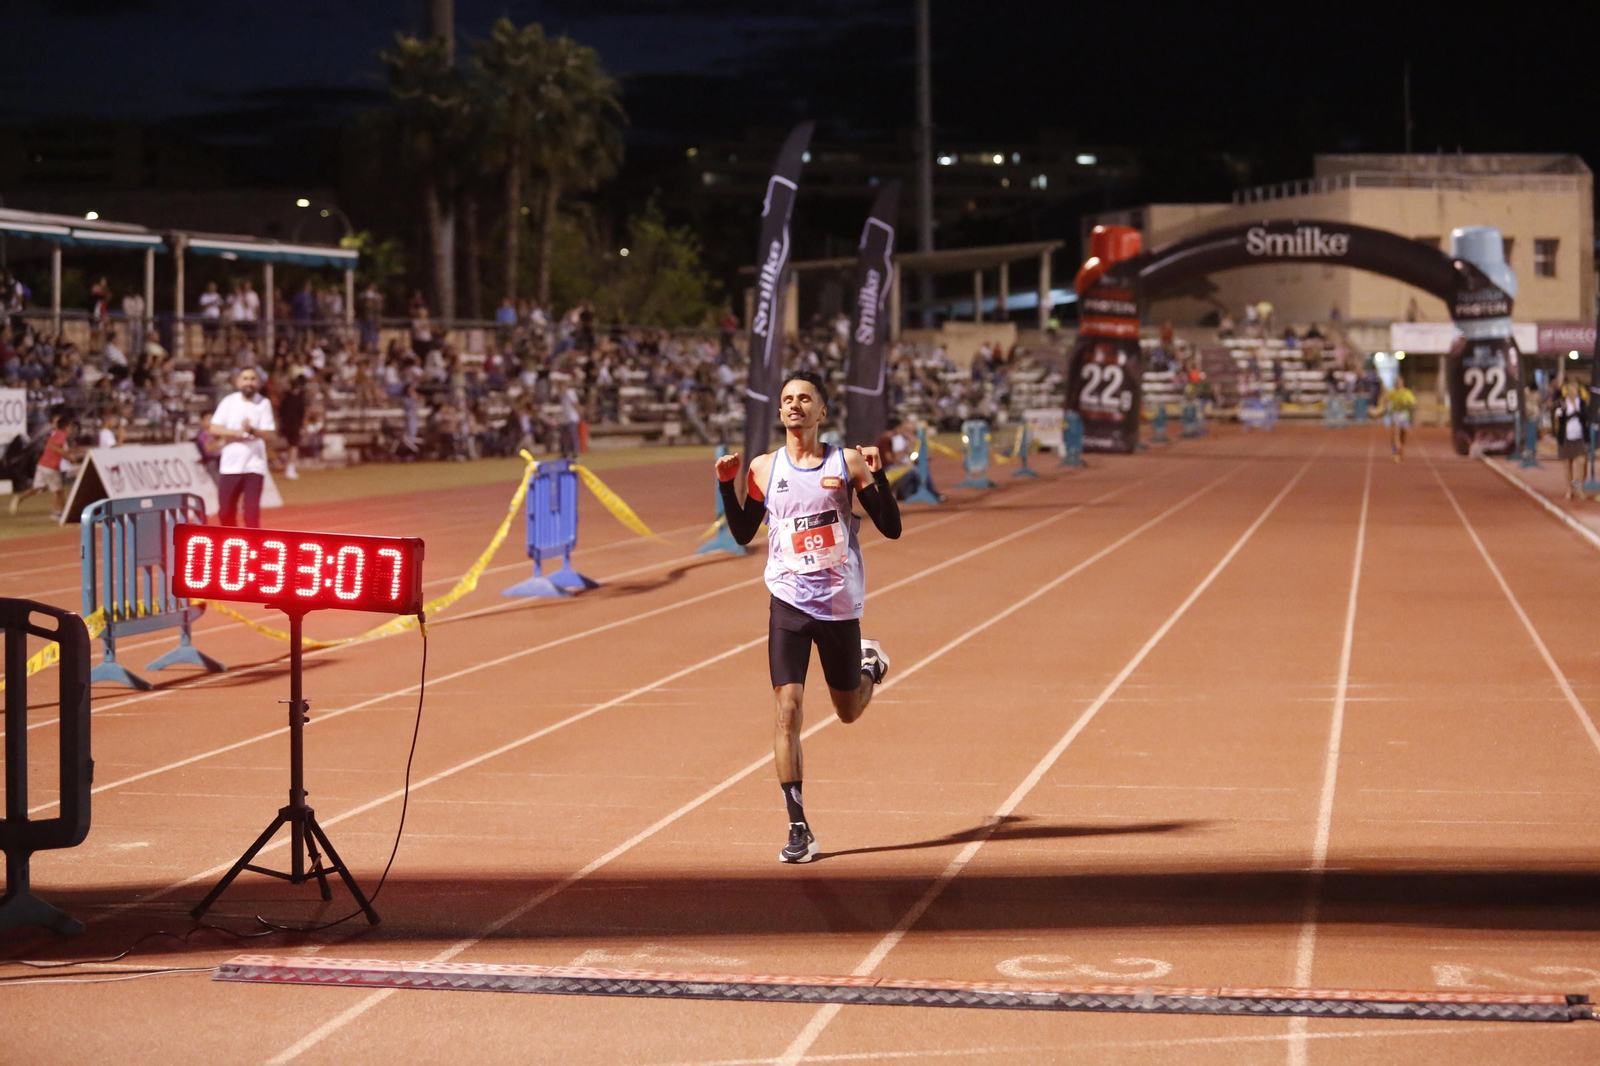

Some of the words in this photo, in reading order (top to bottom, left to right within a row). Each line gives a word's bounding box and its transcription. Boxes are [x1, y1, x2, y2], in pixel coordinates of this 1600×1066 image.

[1246, 226, 1349, 256] Smilke
[753, 239, 781, 337] Smilke
[855, 269, 880, 346] Smilke
[803, 554, 816, 566] H
[804, 534, 824, 551] 69
[184, 536, 402, 600] 00:33:07
